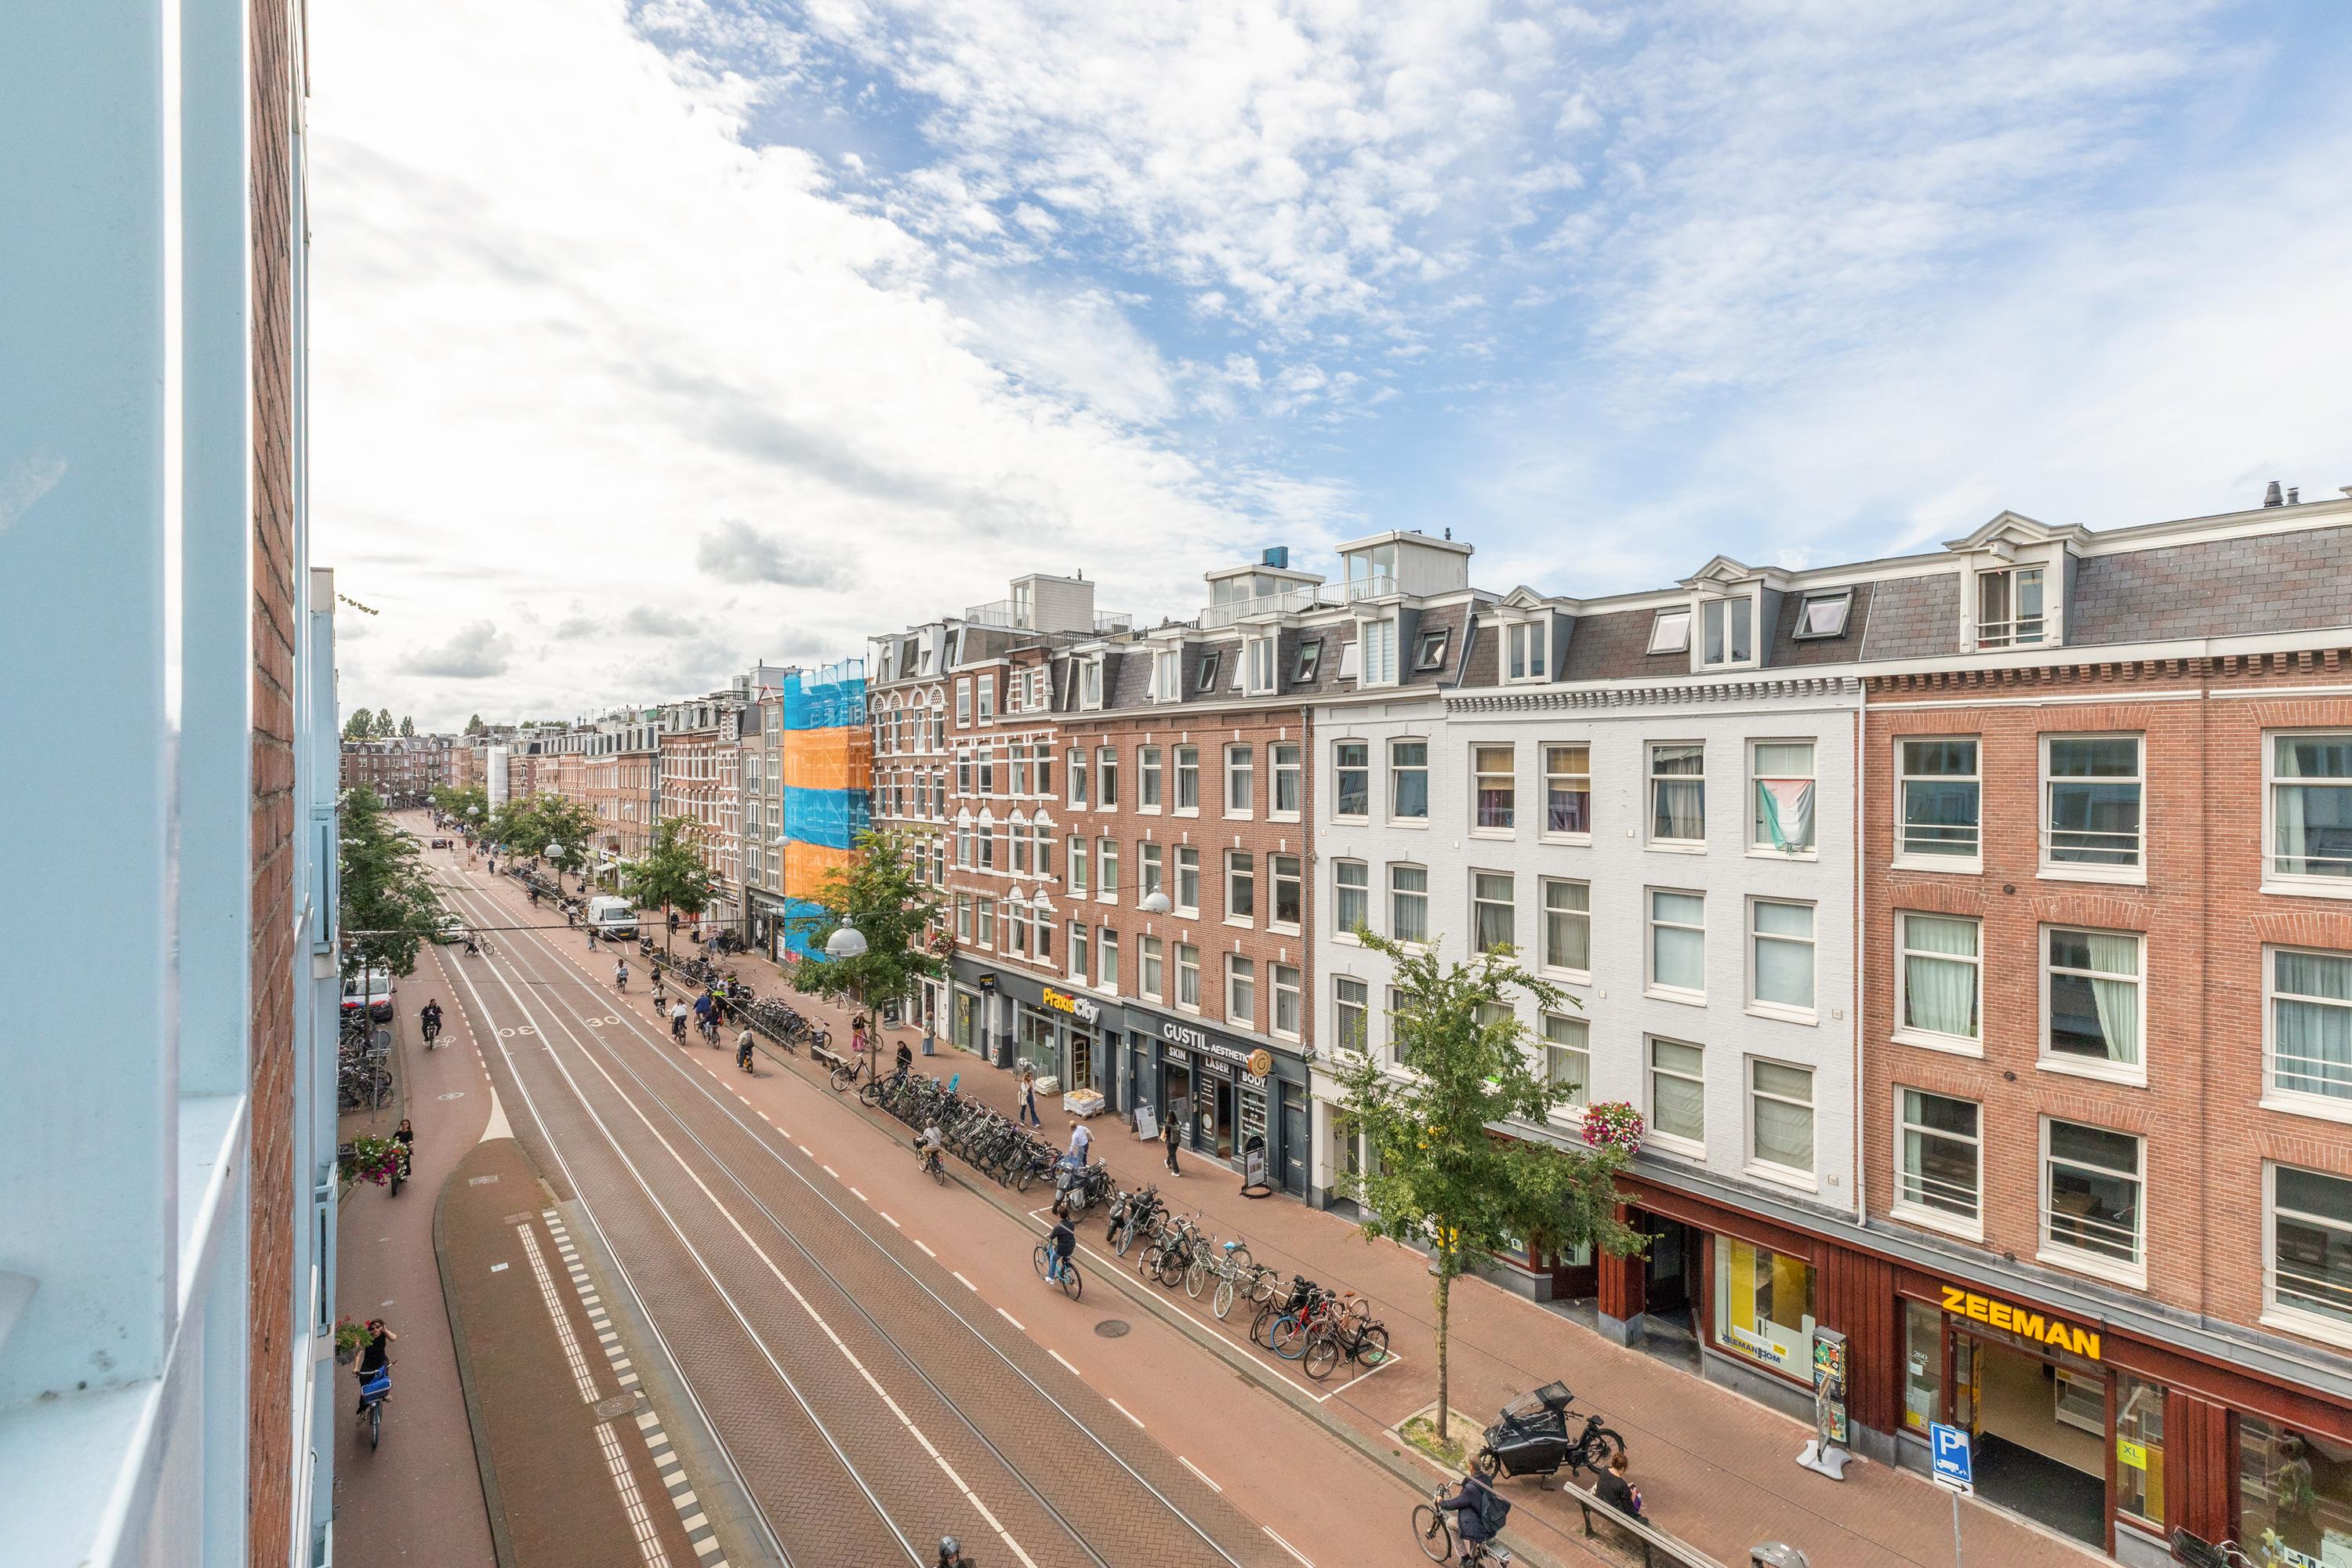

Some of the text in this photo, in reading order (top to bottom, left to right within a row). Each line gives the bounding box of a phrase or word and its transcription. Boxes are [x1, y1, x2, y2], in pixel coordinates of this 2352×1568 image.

[586, 1016, 620, 1027] 30
[1163, 1023, 1210, 1051] GUSTIL
[1168, 1046, 1186, 1061] SKIN
[1205, 1056, 1230, 1074] LASER
[1242, 1071, 1266, 1087] BODY
[1942, 1285, 2100, 1360] ZEEMAN
[1722, 1334, 1781, 1363] ZEEMANCOM
[1940, 1430, 1961, 1455] P
[2123, 1445, 2141, 1459] XL
